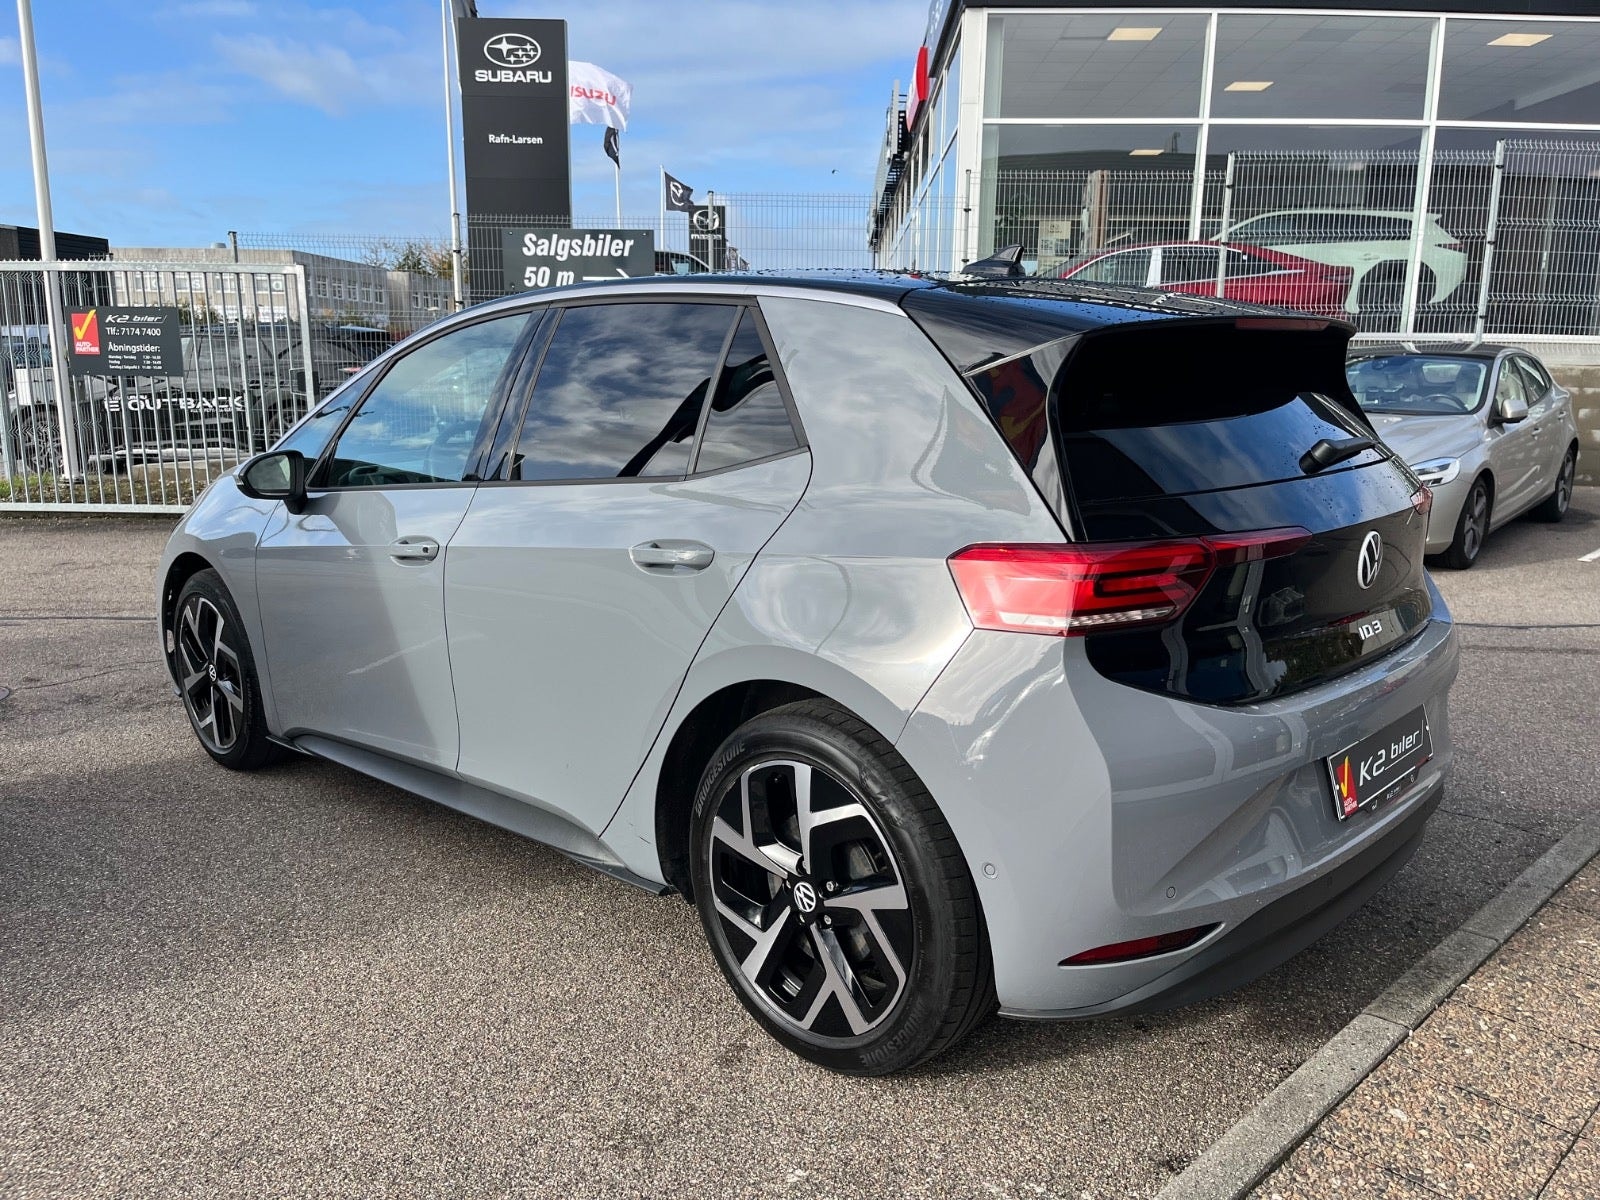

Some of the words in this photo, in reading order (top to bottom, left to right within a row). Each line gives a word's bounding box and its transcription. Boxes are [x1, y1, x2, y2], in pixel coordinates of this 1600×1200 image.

[475, 70, 552, 83] SUBARU
[570, 86, 617, 106] ISUZU
[488, 134, 543, 145] Rafn-Larsen
[522, 233, 634, 261] Salgsbiler
[524, 267, 550, 287] 50
[557, 271, 575, 287] m
[105, 314, 130, 323] K2
[121, 328, 141, 336] 7174
[142, 328, 161, 336] 7400
[108, 342, 161, 354] Åbningstider:
[1359, 749, 1386, 787] K2
[1390, 730, 1420, 759] biler
